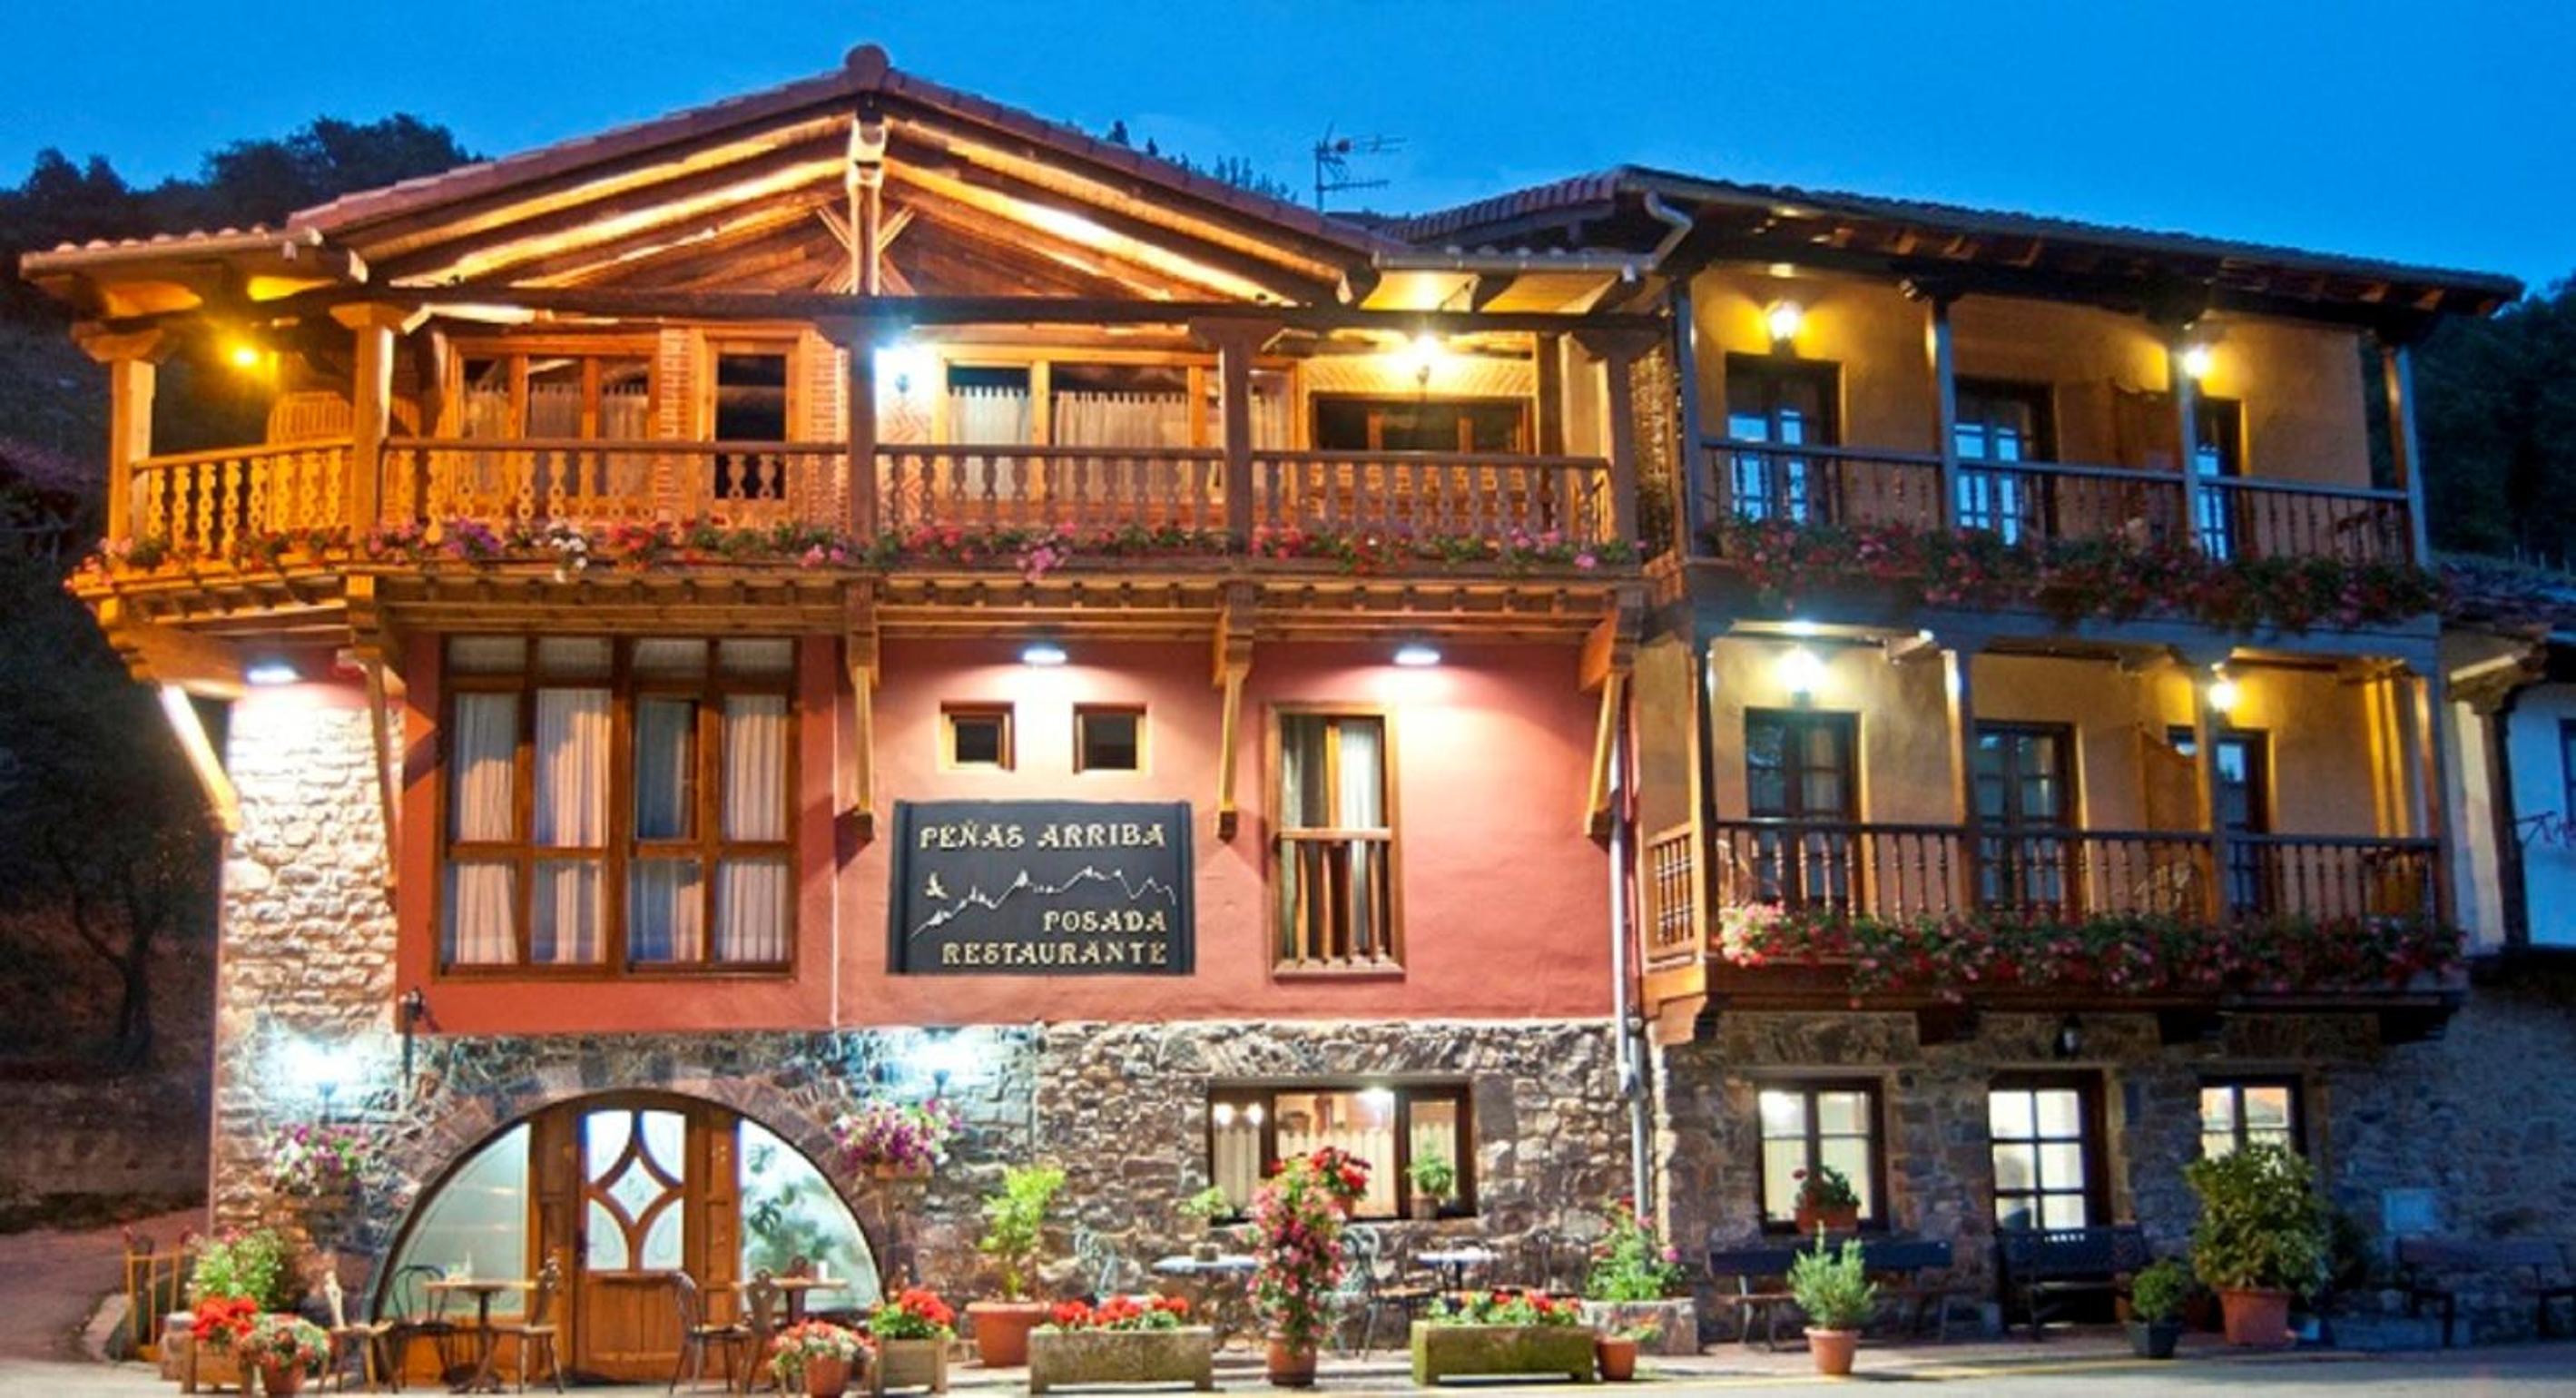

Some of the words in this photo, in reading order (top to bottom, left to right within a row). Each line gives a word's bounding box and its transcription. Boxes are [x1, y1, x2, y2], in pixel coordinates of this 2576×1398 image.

[919, 820, 1025, 848] PEÑAS
[1037, 823, 1165, 847] ARRIBA
[1044, 911, 1167, 931] POSADA
[942, 942, 1167, 964] RESTAURANTE
